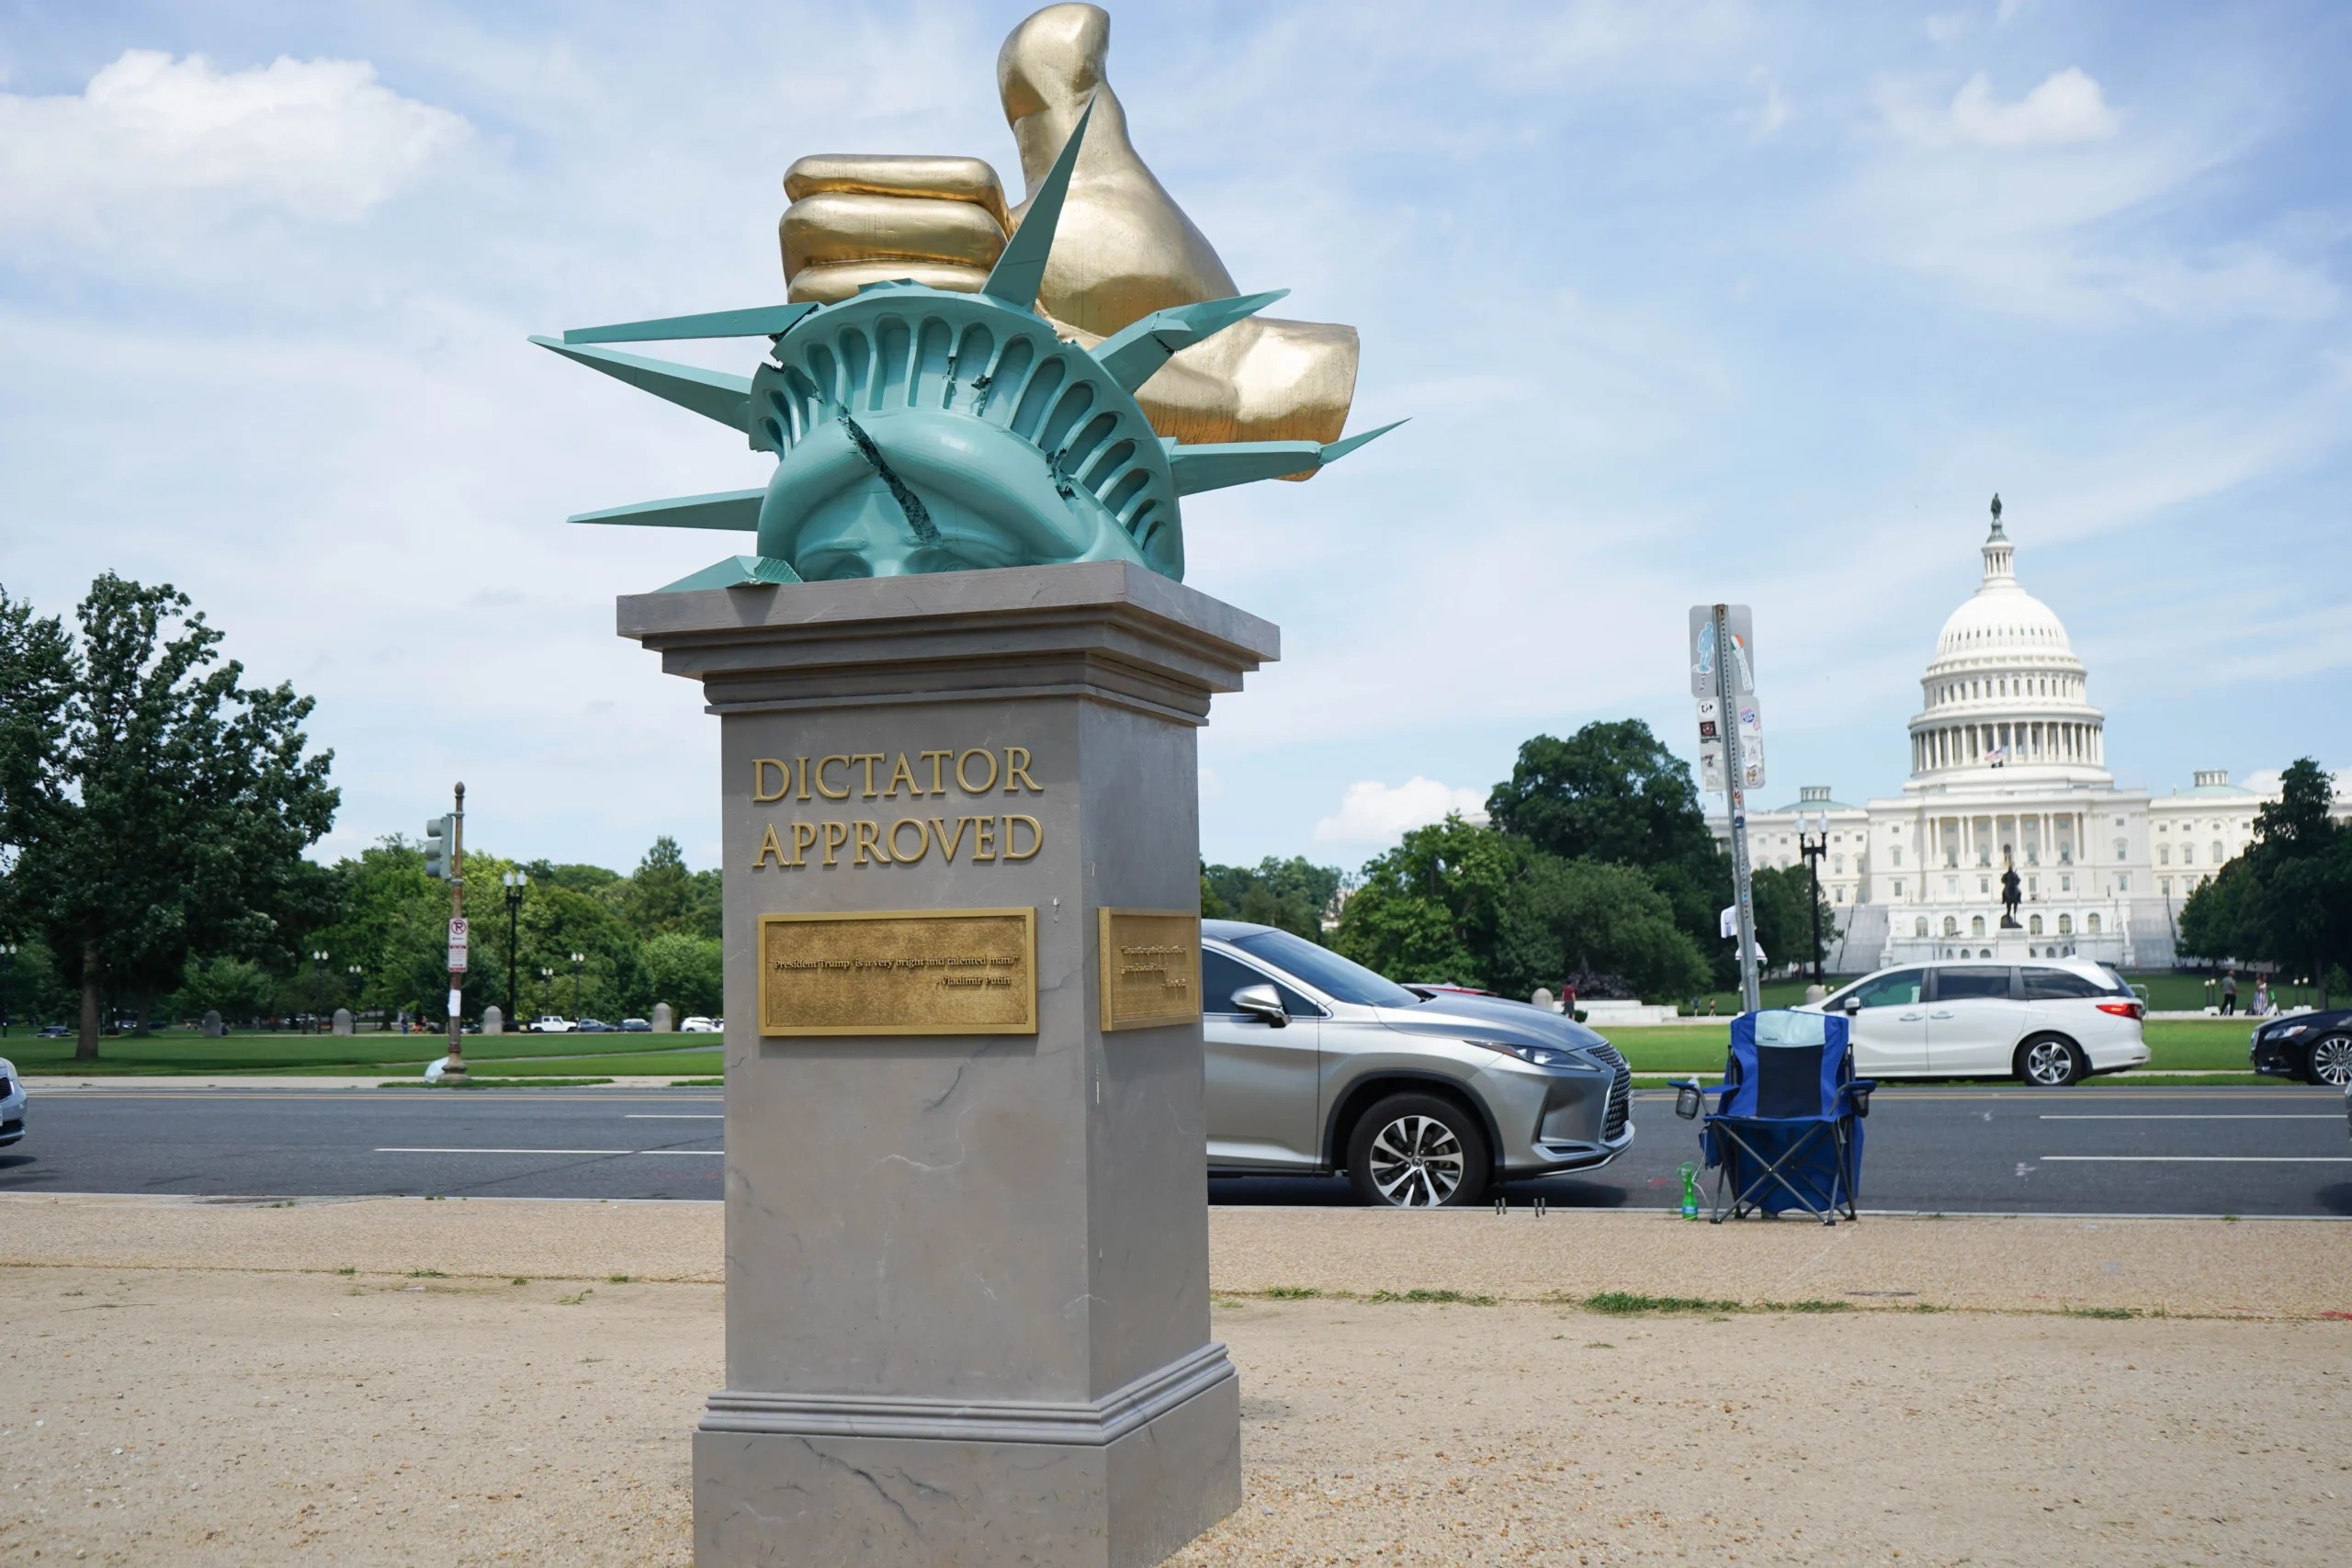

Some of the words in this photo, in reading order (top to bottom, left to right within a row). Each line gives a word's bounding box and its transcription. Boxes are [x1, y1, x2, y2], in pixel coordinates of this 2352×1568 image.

[752, 746, 1044, 803] DICTATOR
[752, 814, 1044, 868] APPROVED
[775, 960, 818, 969] President
[819, 959, 850, 970] Trump
[865, 959, 872, 967] a
[874, 959, 894, 969] very
[896, 956, 924, 967] bright
[926, 956, 945, 965] and
[947, 956, 988, 965] talented
[985, 976, 1012, 986] Putin
